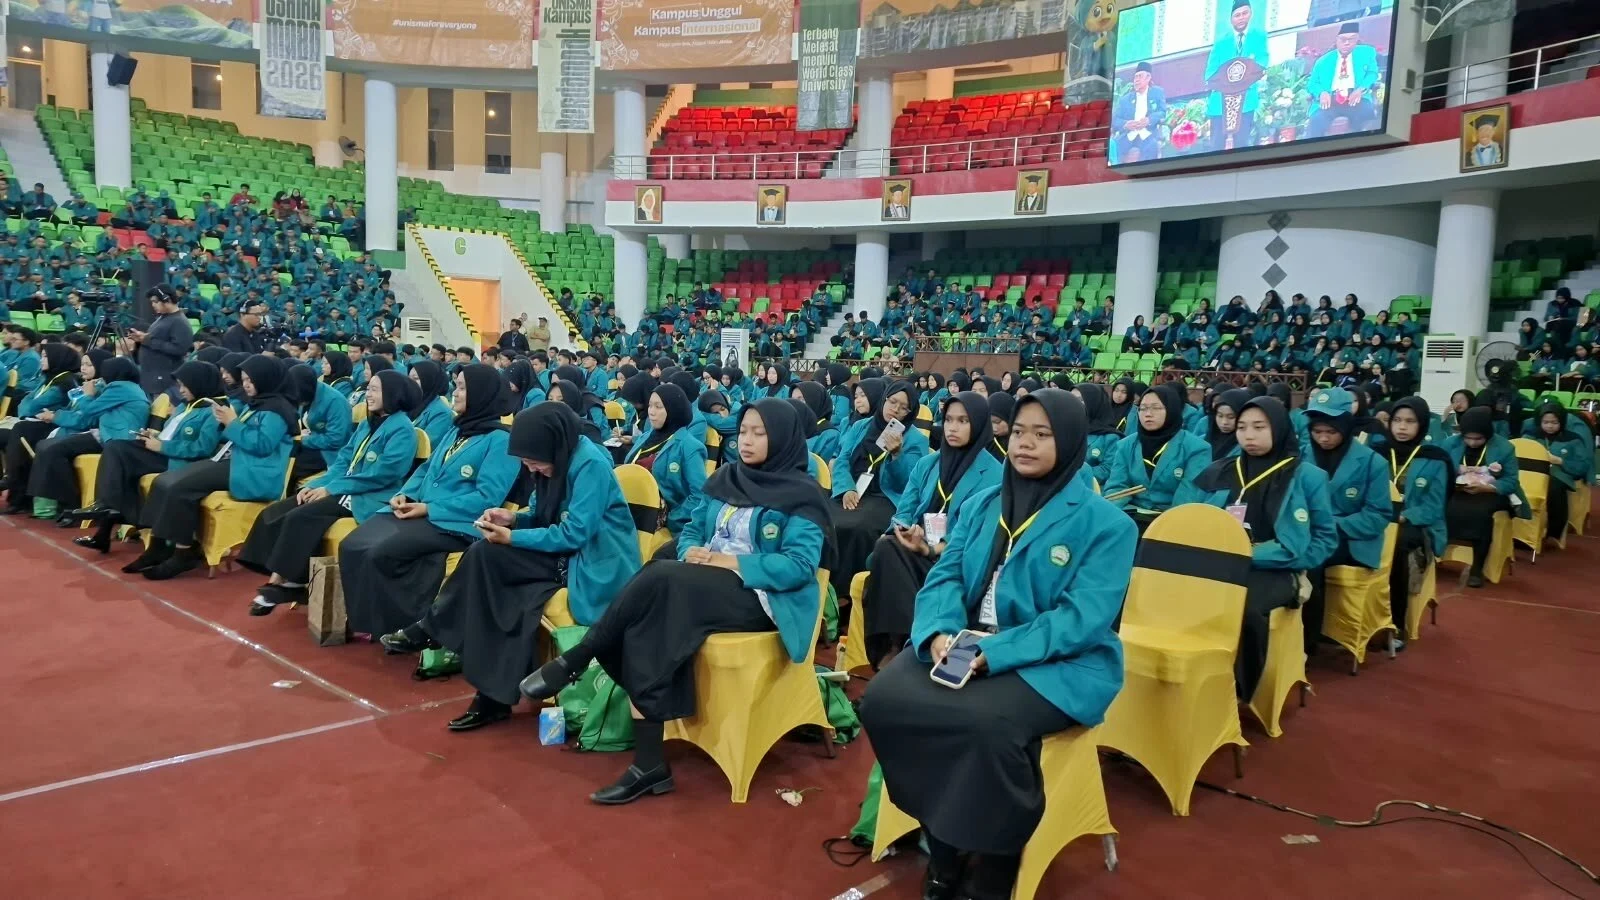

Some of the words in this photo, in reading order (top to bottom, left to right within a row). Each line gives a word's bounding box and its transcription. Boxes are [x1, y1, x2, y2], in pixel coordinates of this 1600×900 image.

[543, 7, 592, 28] Kampus
[651, 7, 699, 21] Kampus
[701, 5, 742, 18] Unggul
[392, 19, 477, 31] #unismaforeveryone
[634, 25, 681, 37] Kampus
[802, 27, 839, 41] Terbang
[802, 40, 839, 54] Melesat
[802, 52, 837, 67] menuju
[267, 59, 322, 91] 2026
[802, 65, 828, 80] World
[829, 64, 854, 78] Class
[801, 77, 847, 92] University
[454, 236, 467, 256] C
